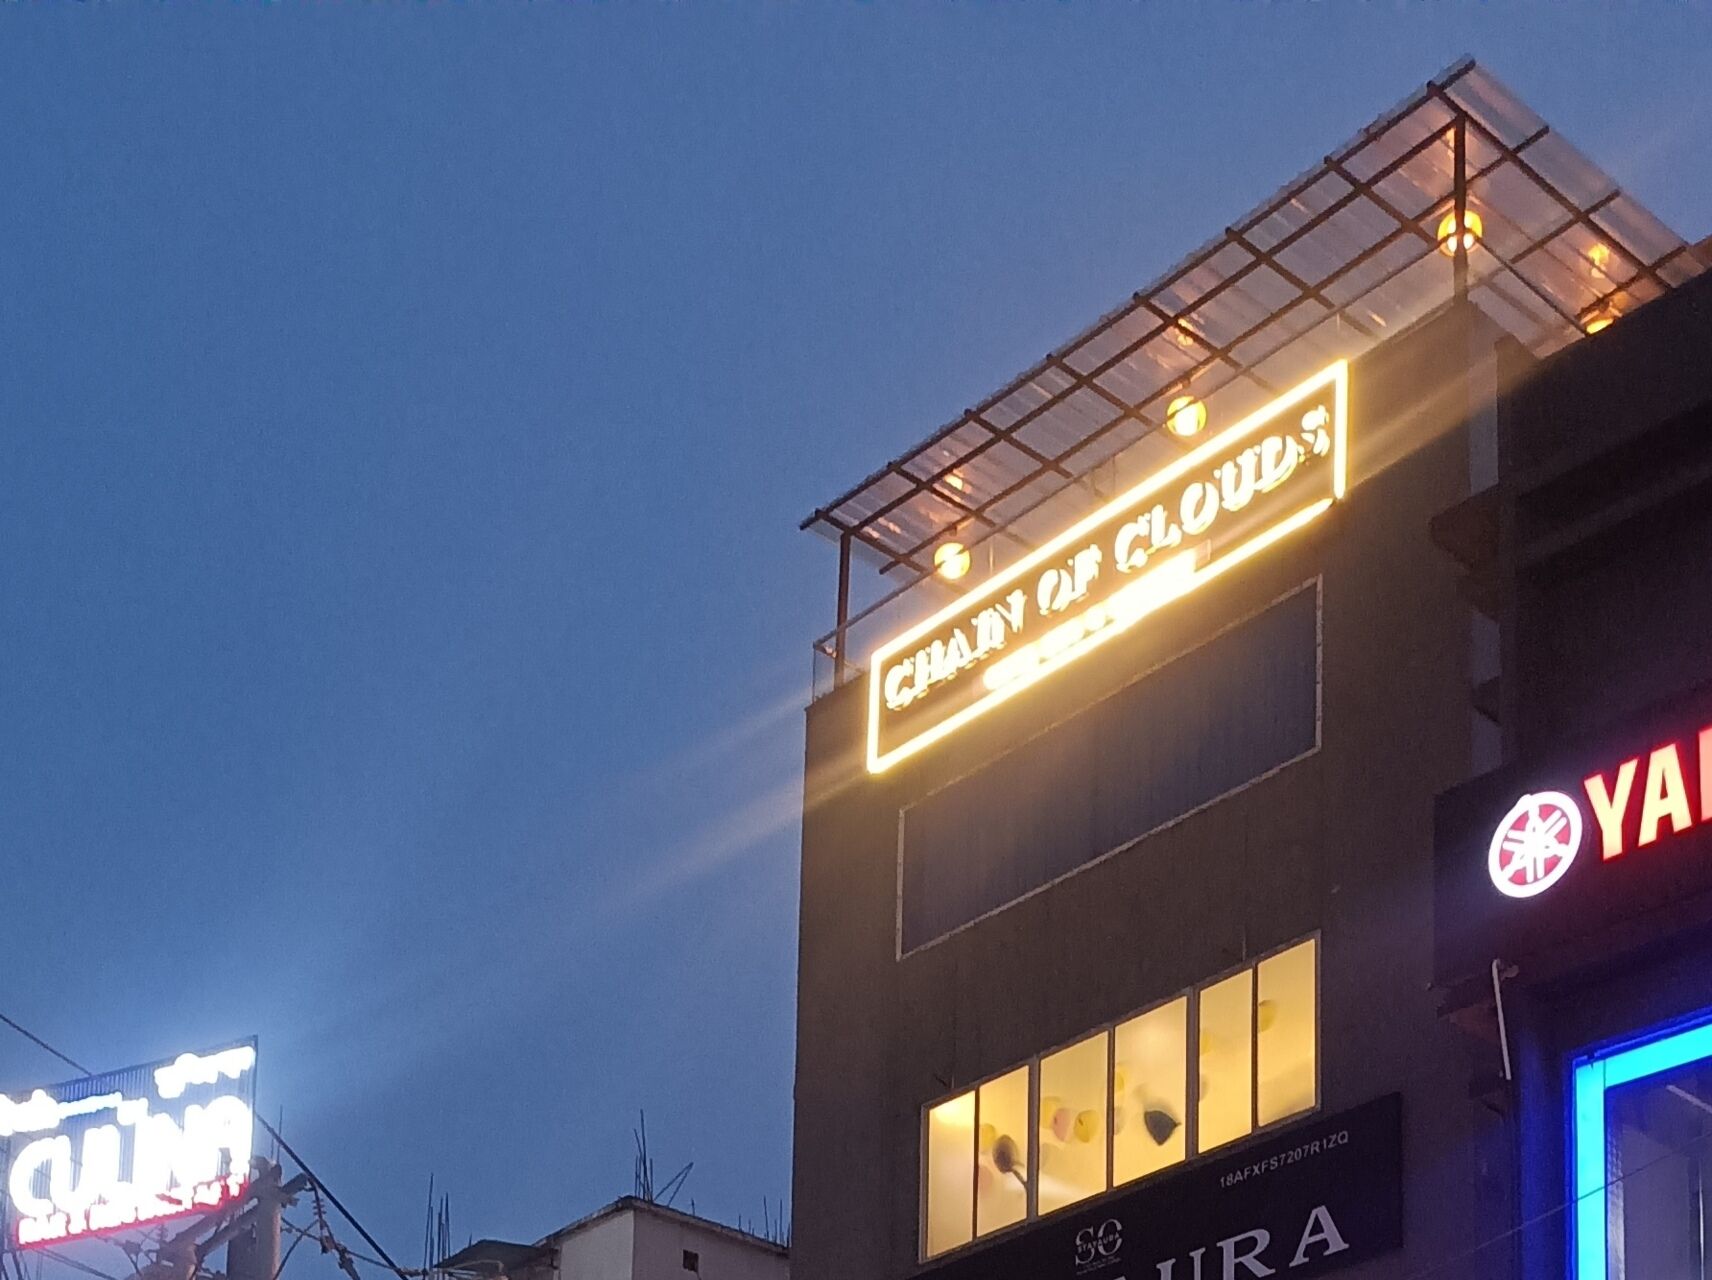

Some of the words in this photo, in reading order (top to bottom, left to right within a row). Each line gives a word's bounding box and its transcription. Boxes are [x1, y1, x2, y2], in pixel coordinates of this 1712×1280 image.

[884, 588, 1028, 711] CHAIN
[1037, 544, 1103, 616] OF
[1114, 404, 1331, 574] CLOUDS
[1583, 725, 1712, 862] YA
[1219, 1130, 1350, 1189] 18AFXFS7207R1ZQ
